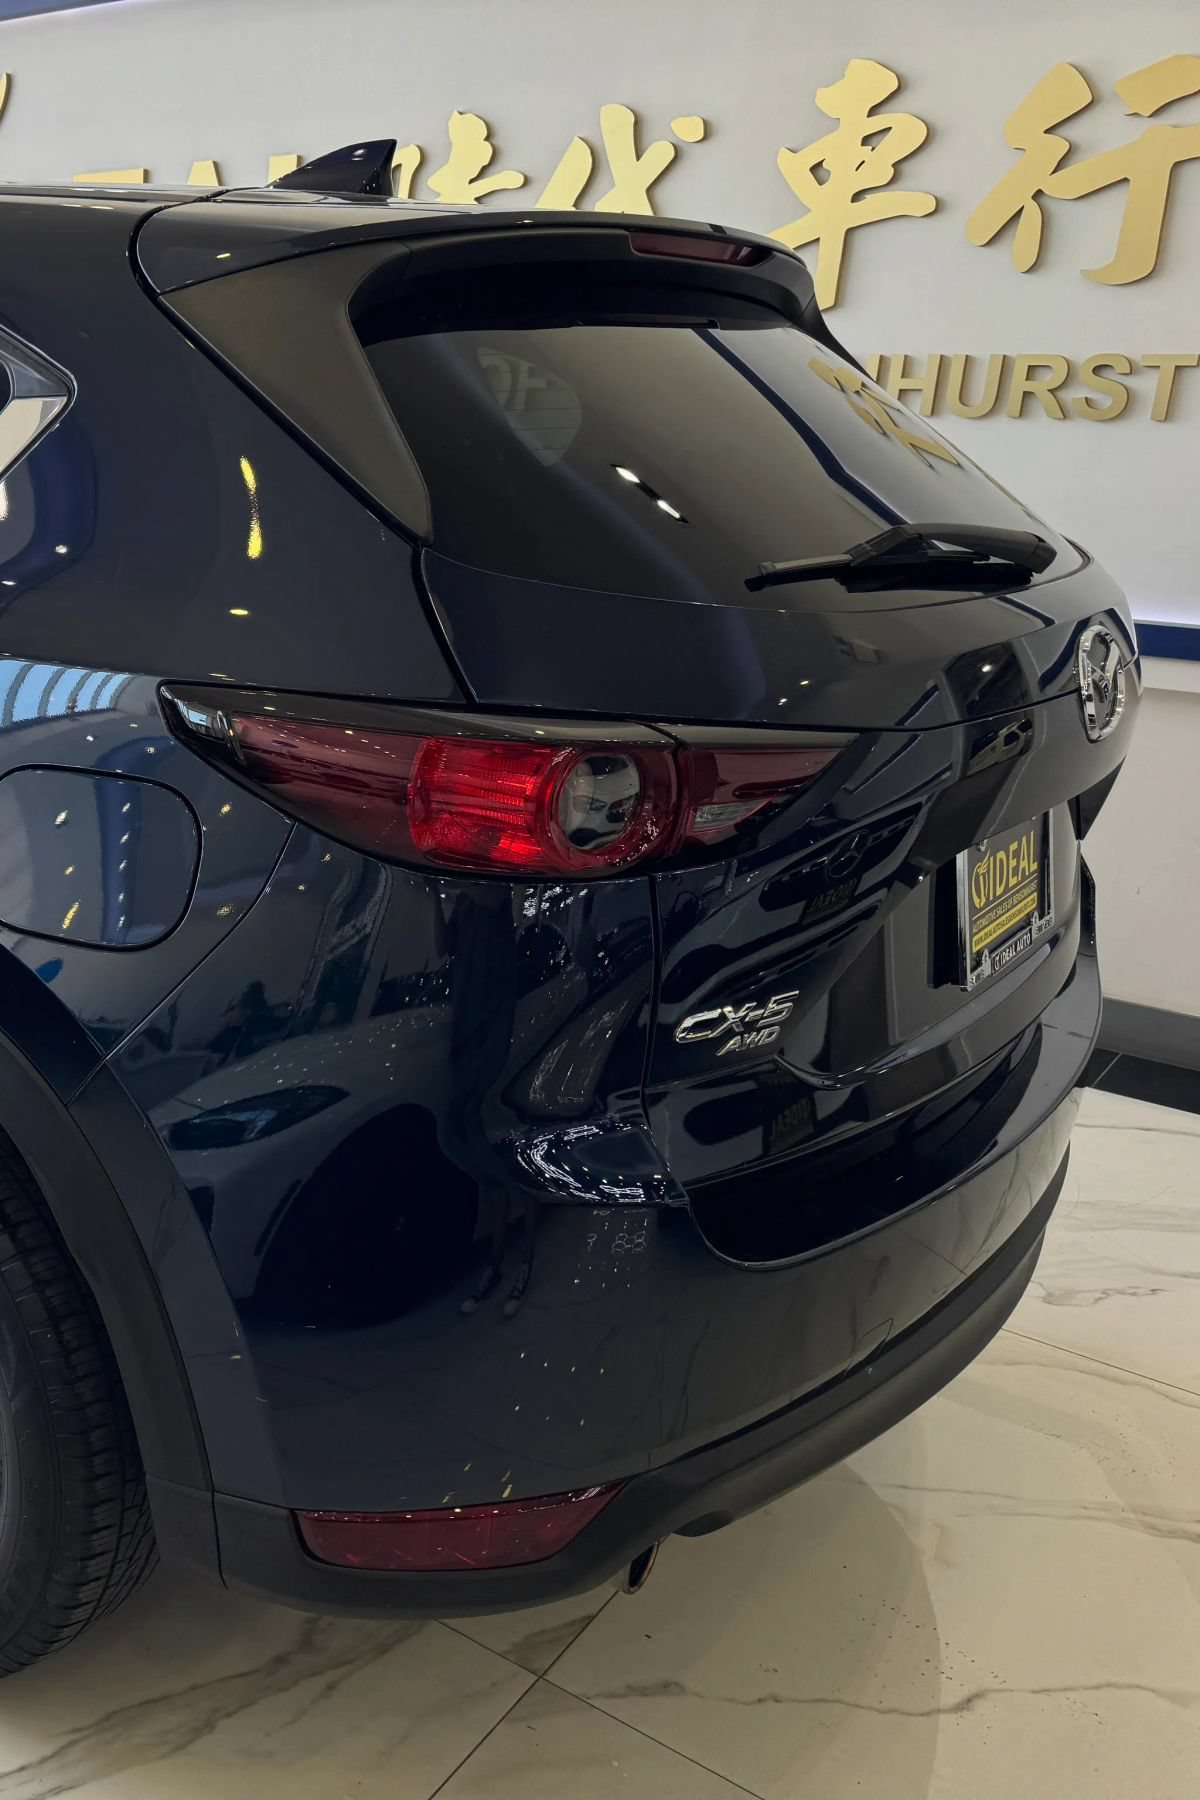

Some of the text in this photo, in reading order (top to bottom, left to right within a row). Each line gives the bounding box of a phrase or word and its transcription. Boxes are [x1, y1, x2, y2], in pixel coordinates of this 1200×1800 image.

[989, 830, 1039, 901] IDEAL
[1016, 933, 1031, 955] AUTO
[674, 990, 800, 1044] CX-5
[714, 1025, 781, 1057] AWD
